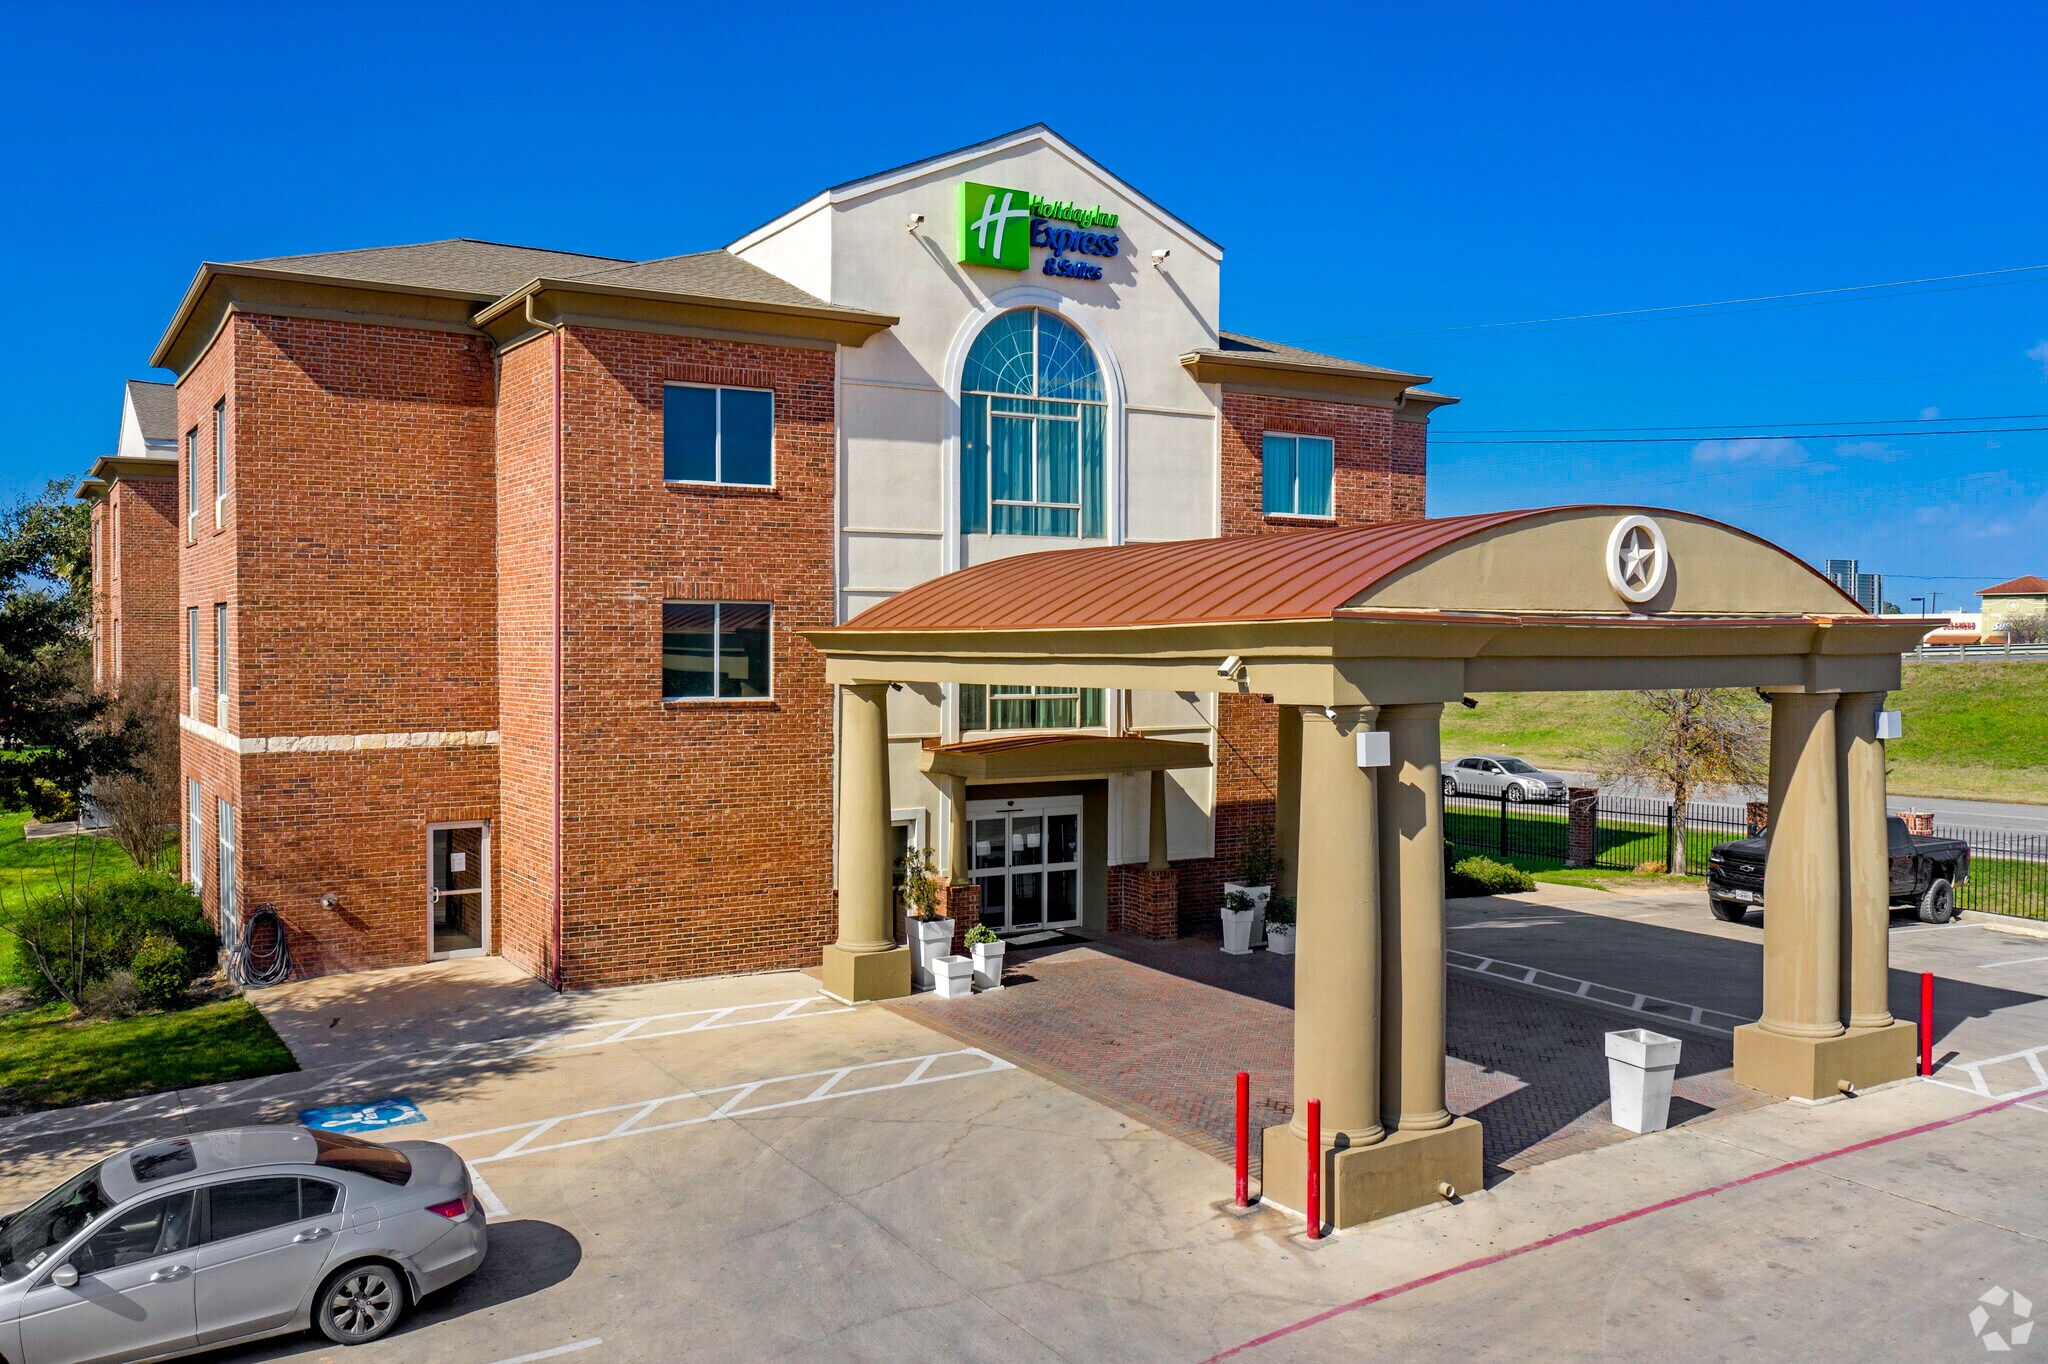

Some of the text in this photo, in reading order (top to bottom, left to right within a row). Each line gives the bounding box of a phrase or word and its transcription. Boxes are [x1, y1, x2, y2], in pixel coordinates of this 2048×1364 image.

[1029, 195, 1119, 229] Holiday Inn
[1030, 218, 1119, 257] Express
[1043, 258, 1103, 280] & Suites
